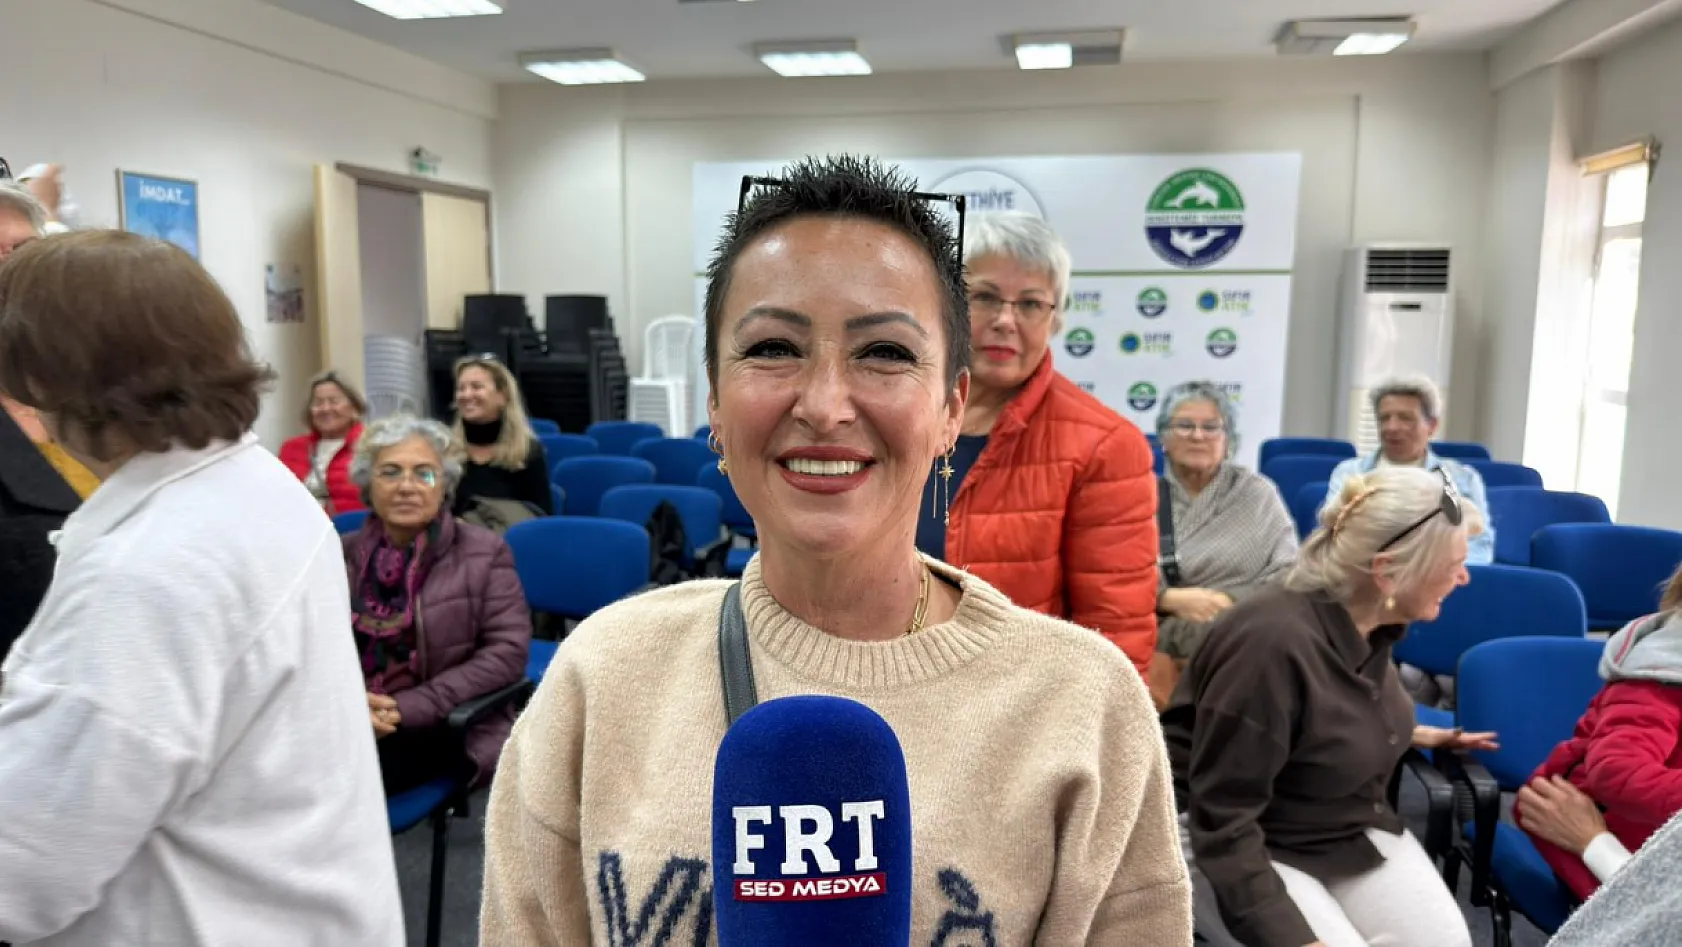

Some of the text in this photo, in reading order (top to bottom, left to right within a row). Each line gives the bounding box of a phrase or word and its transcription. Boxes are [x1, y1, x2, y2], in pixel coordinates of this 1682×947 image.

[948, 187, 1013, 211] THİYE
[732, 800, 885, 875] FRT
[740, 876, 881, 897] SED MEDYA
